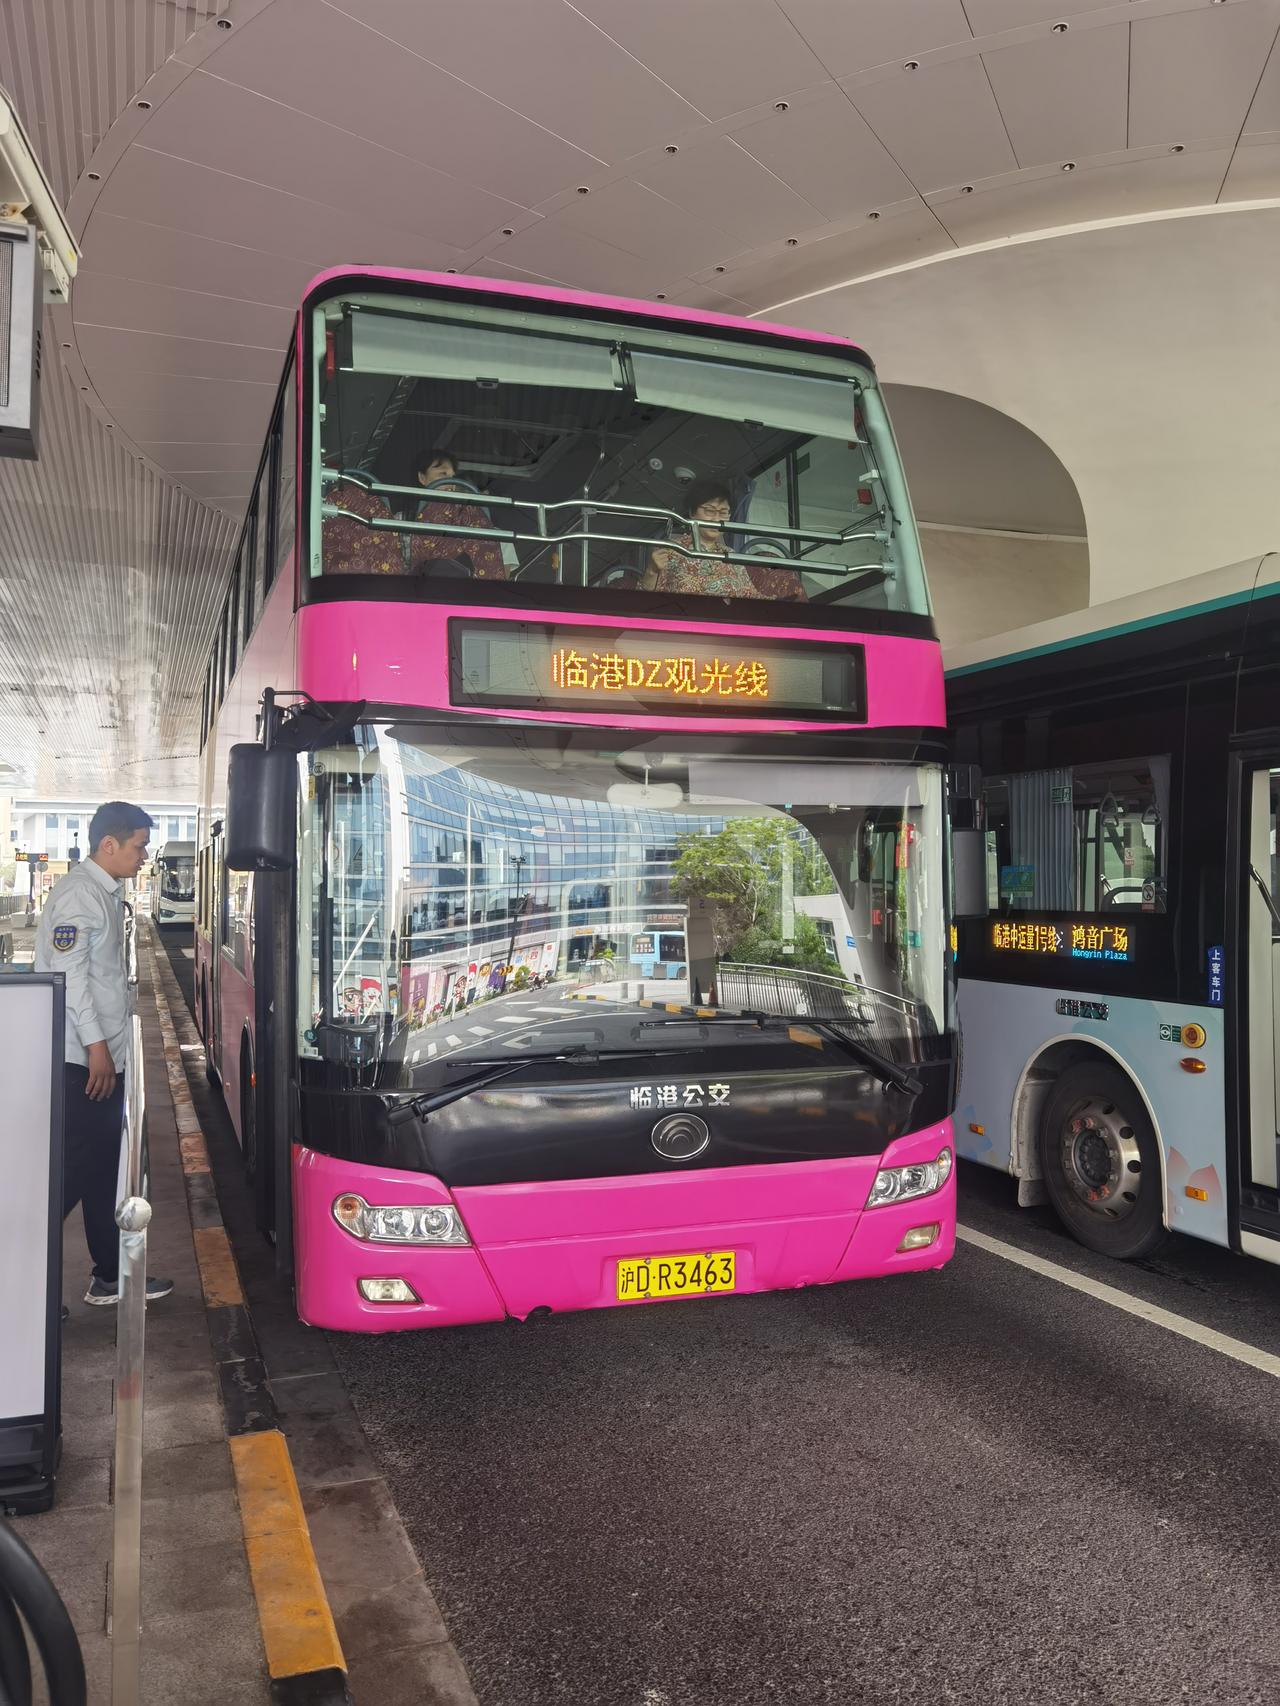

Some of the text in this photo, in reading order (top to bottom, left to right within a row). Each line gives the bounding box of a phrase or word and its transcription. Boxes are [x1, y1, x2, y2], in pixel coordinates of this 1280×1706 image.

[553, 649, 768, 696] 临港DZ观光线
[1071, 925, 1129, 951] 鸿音广场
[1072, 948, 1128, 960] Hongyin Plaza
[1211, 949, 1221, 1001] 上客车门
[630, 1084, 731, 1109] 临港公交
